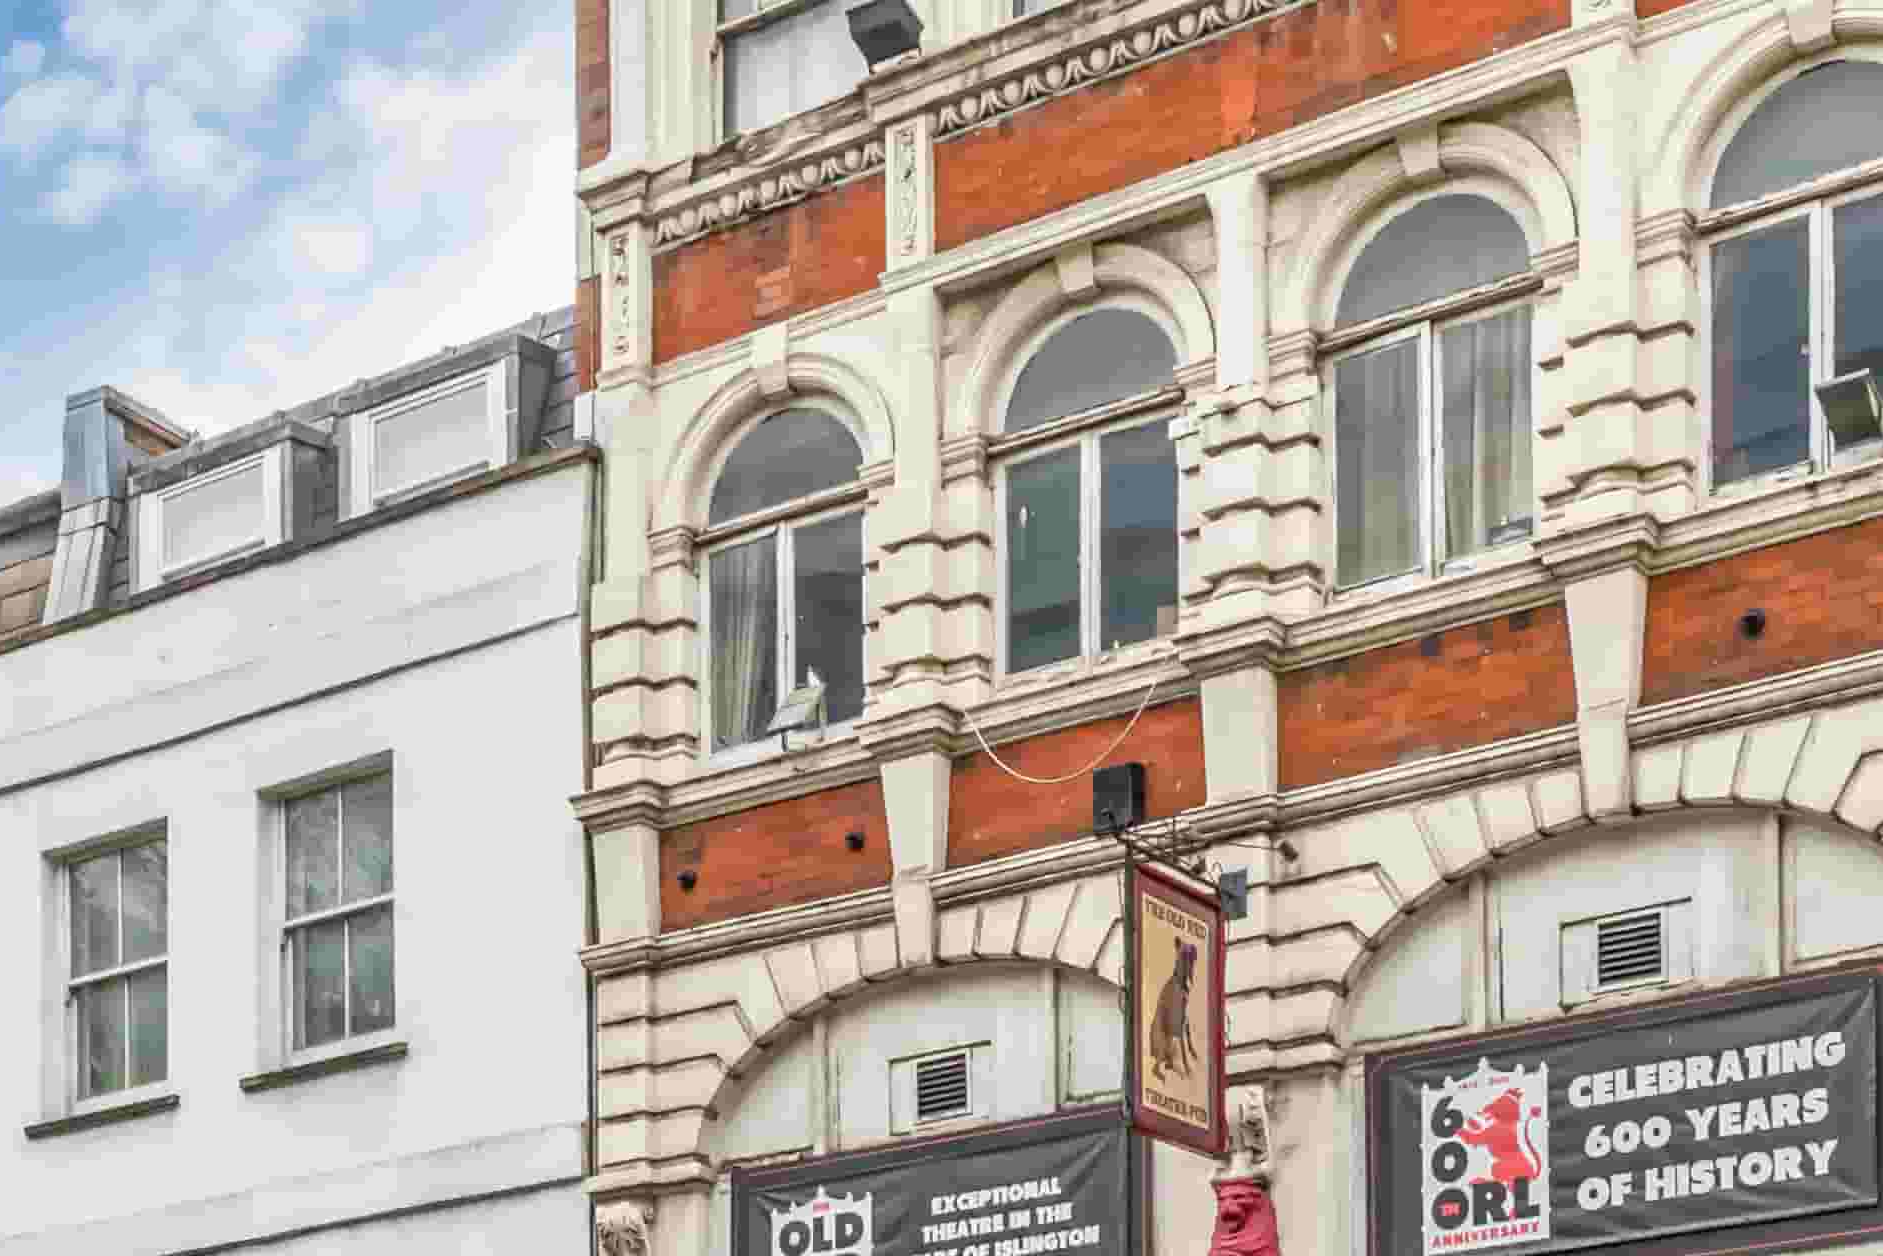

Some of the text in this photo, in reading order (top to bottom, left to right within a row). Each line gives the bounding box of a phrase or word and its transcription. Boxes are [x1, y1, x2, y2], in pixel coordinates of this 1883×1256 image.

[1568, 1031, 1846, 1108] CELEBRATING
[1584, 1087, 1829, 1159] 600 YEARS
[930, 1176, 1062, 1216] EXCEPTIONAL
[1576, 1138, 1838, 1210] OF HISTORY
[778, 1212, 865, 1256] OLD
[922, 1202, 1074, 1244] THEATRE IN THE
[1430, 1221, 1540, 1249] ANNIVERSARY
